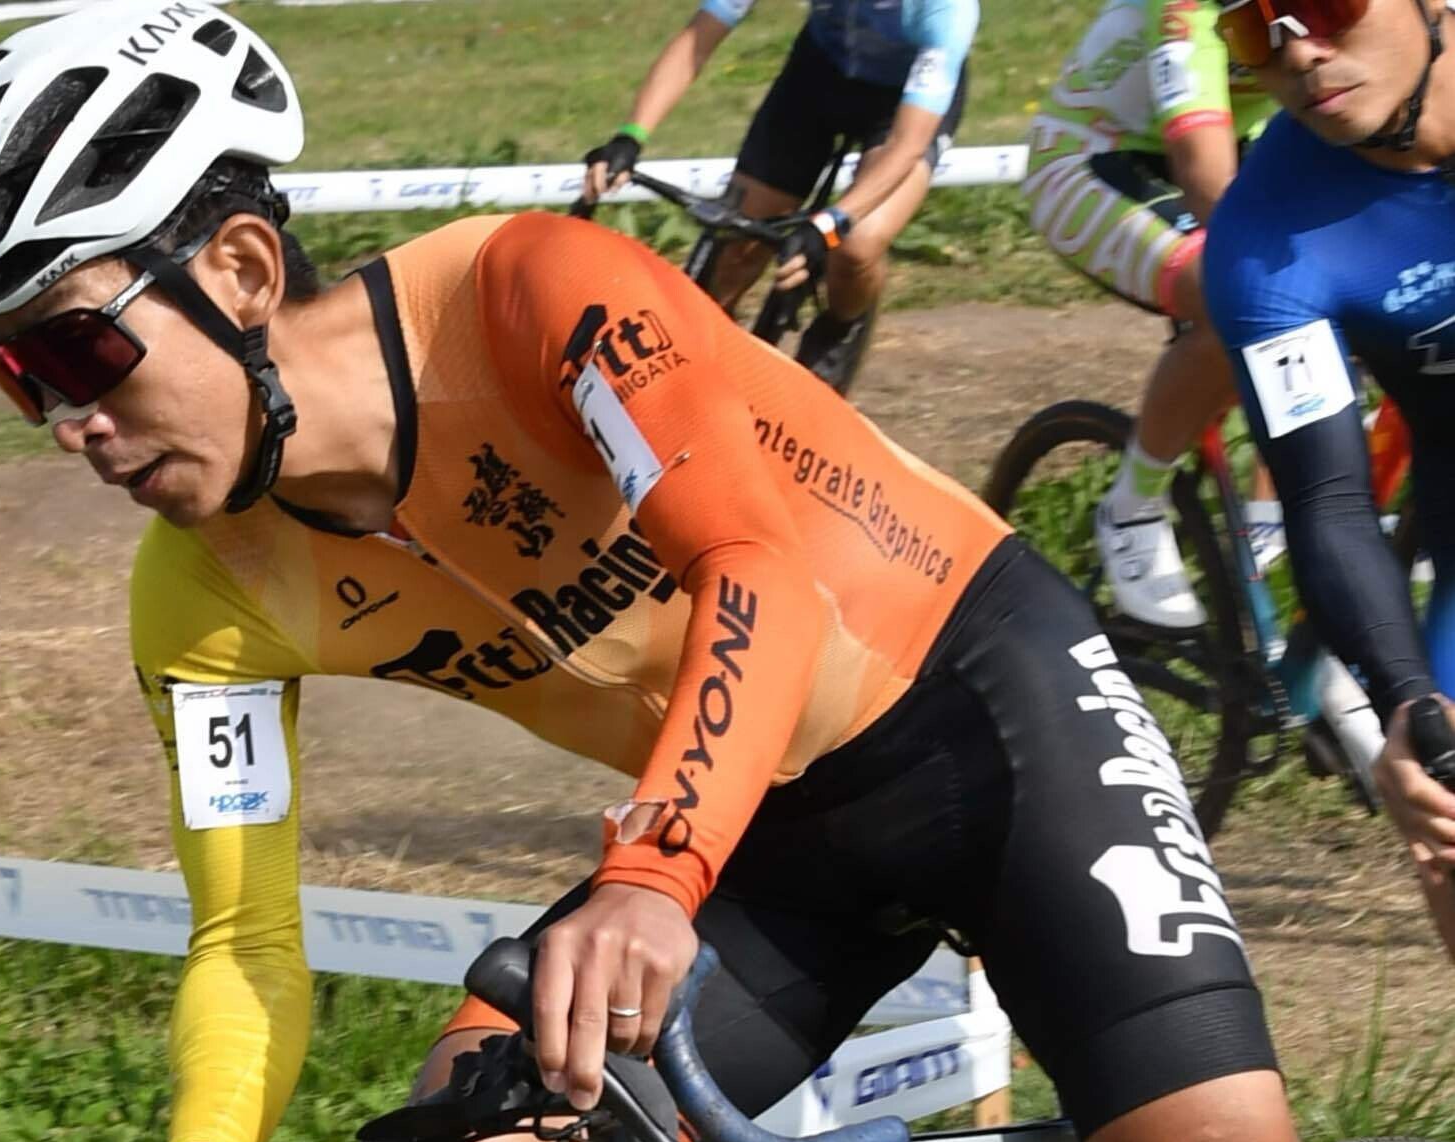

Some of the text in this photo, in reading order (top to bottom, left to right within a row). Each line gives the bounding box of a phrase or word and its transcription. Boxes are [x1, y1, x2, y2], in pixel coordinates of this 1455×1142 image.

[748, 404, 954, 586] ntegrate Graphics
[208, 713, 255, 768] 51
[851, 1042, 961, 1107] GIANT
